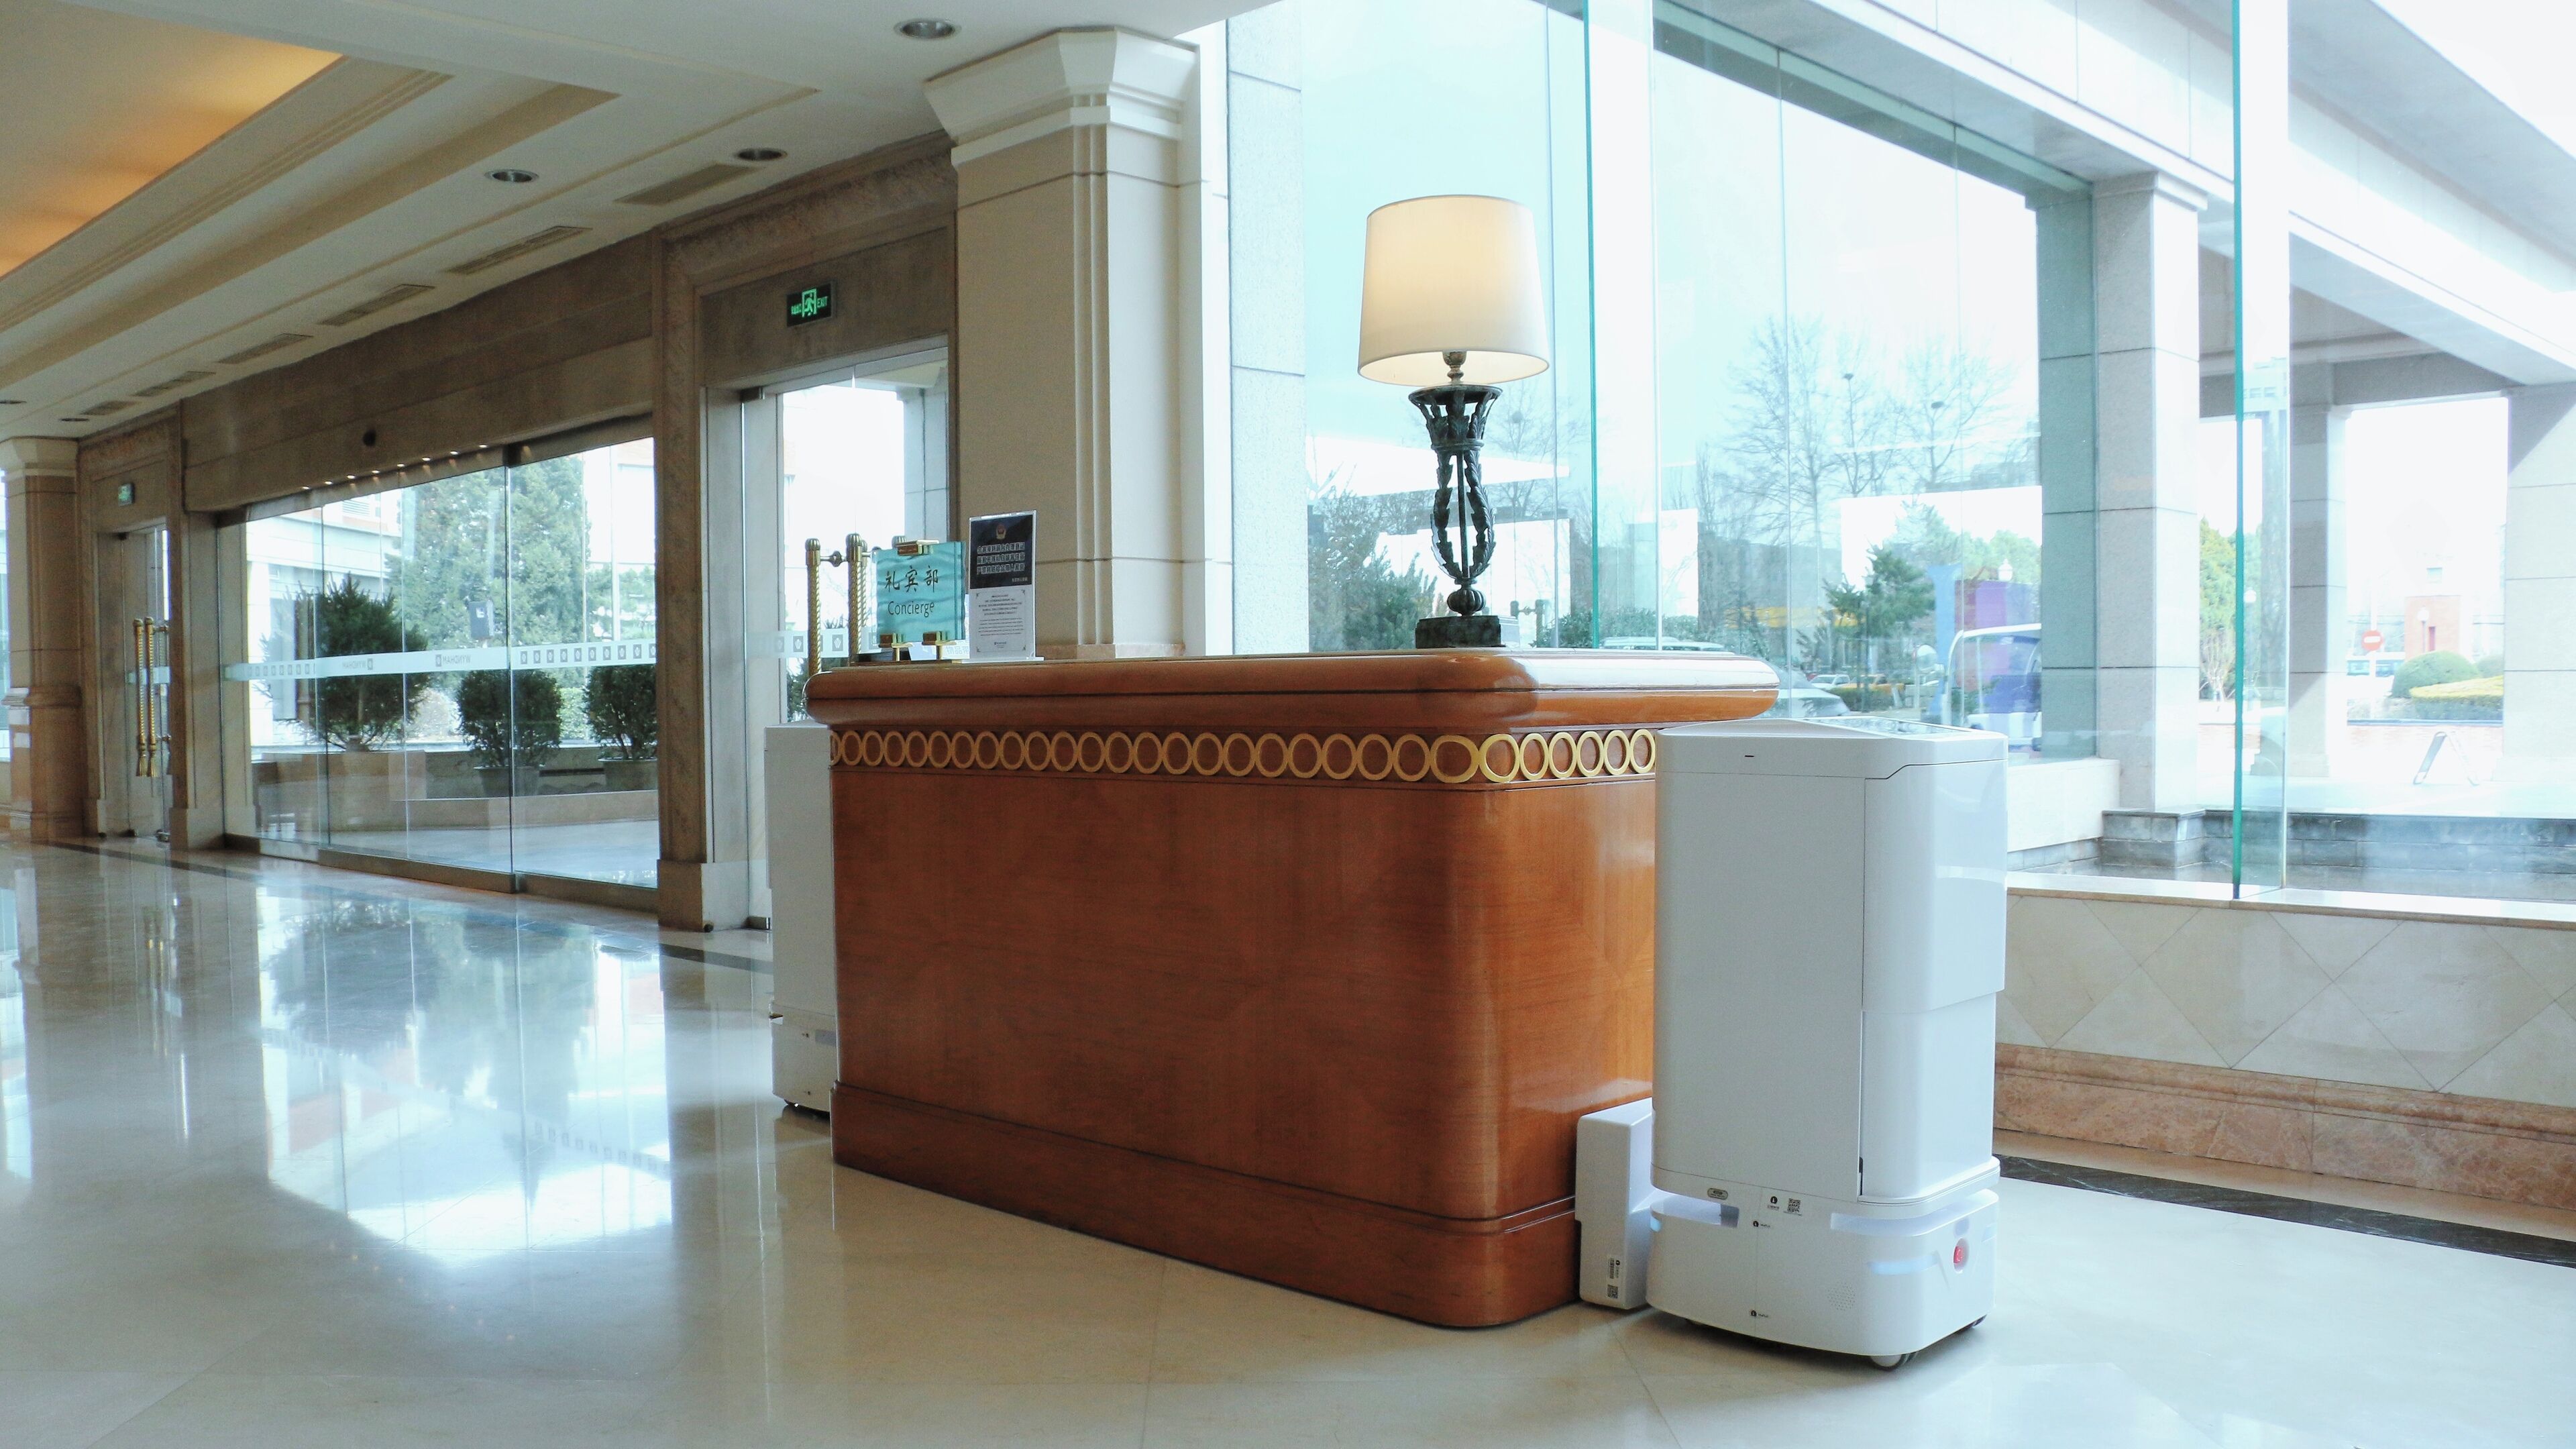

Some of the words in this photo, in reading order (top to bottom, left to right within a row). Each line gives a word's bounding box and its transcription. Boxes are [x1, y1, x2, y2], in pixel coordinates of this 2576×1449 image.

[817, 297, 828, 309] EXIT
[885, 565, 938, 593] 礼宾部
[888, 601, 935, 618] Concierge
